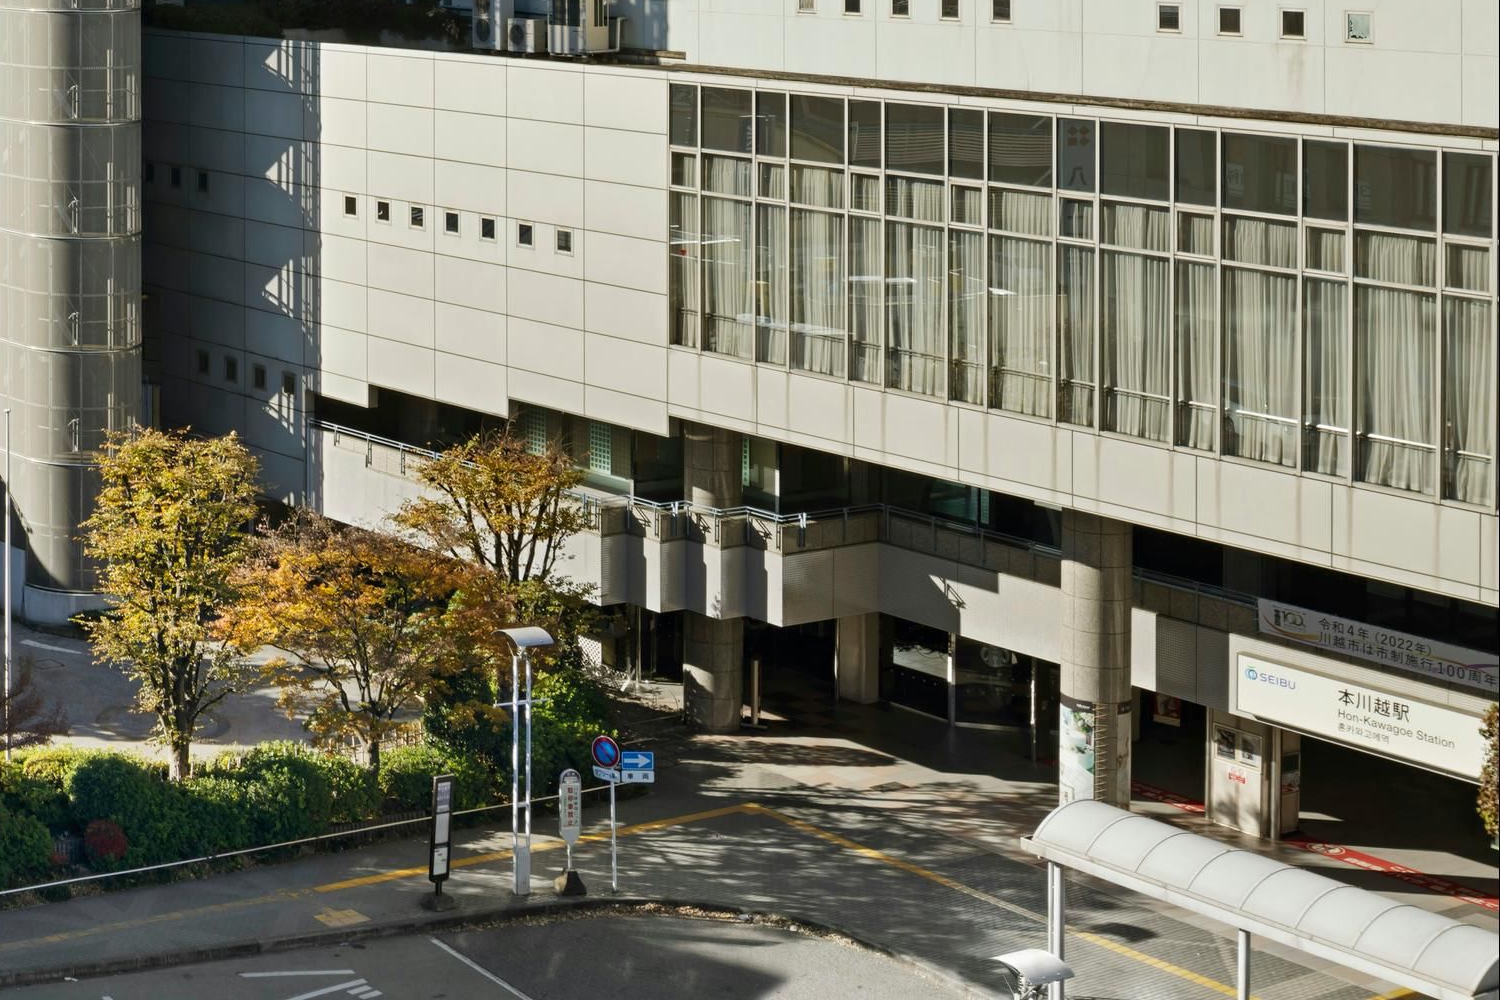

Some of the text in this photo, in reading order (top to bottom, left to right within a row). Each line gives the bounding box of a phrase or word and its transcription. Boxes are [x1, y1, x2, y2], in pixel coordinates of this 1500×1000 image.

[1318, 631, 1497, 688] 川越市は市制施行100周年
[1259, 672, 1296, 691] SEIBU
[1338, 689, 1410, 723] 本川越駅
[1338, 708, 1455, 750] Hon-Kawagoe Station
